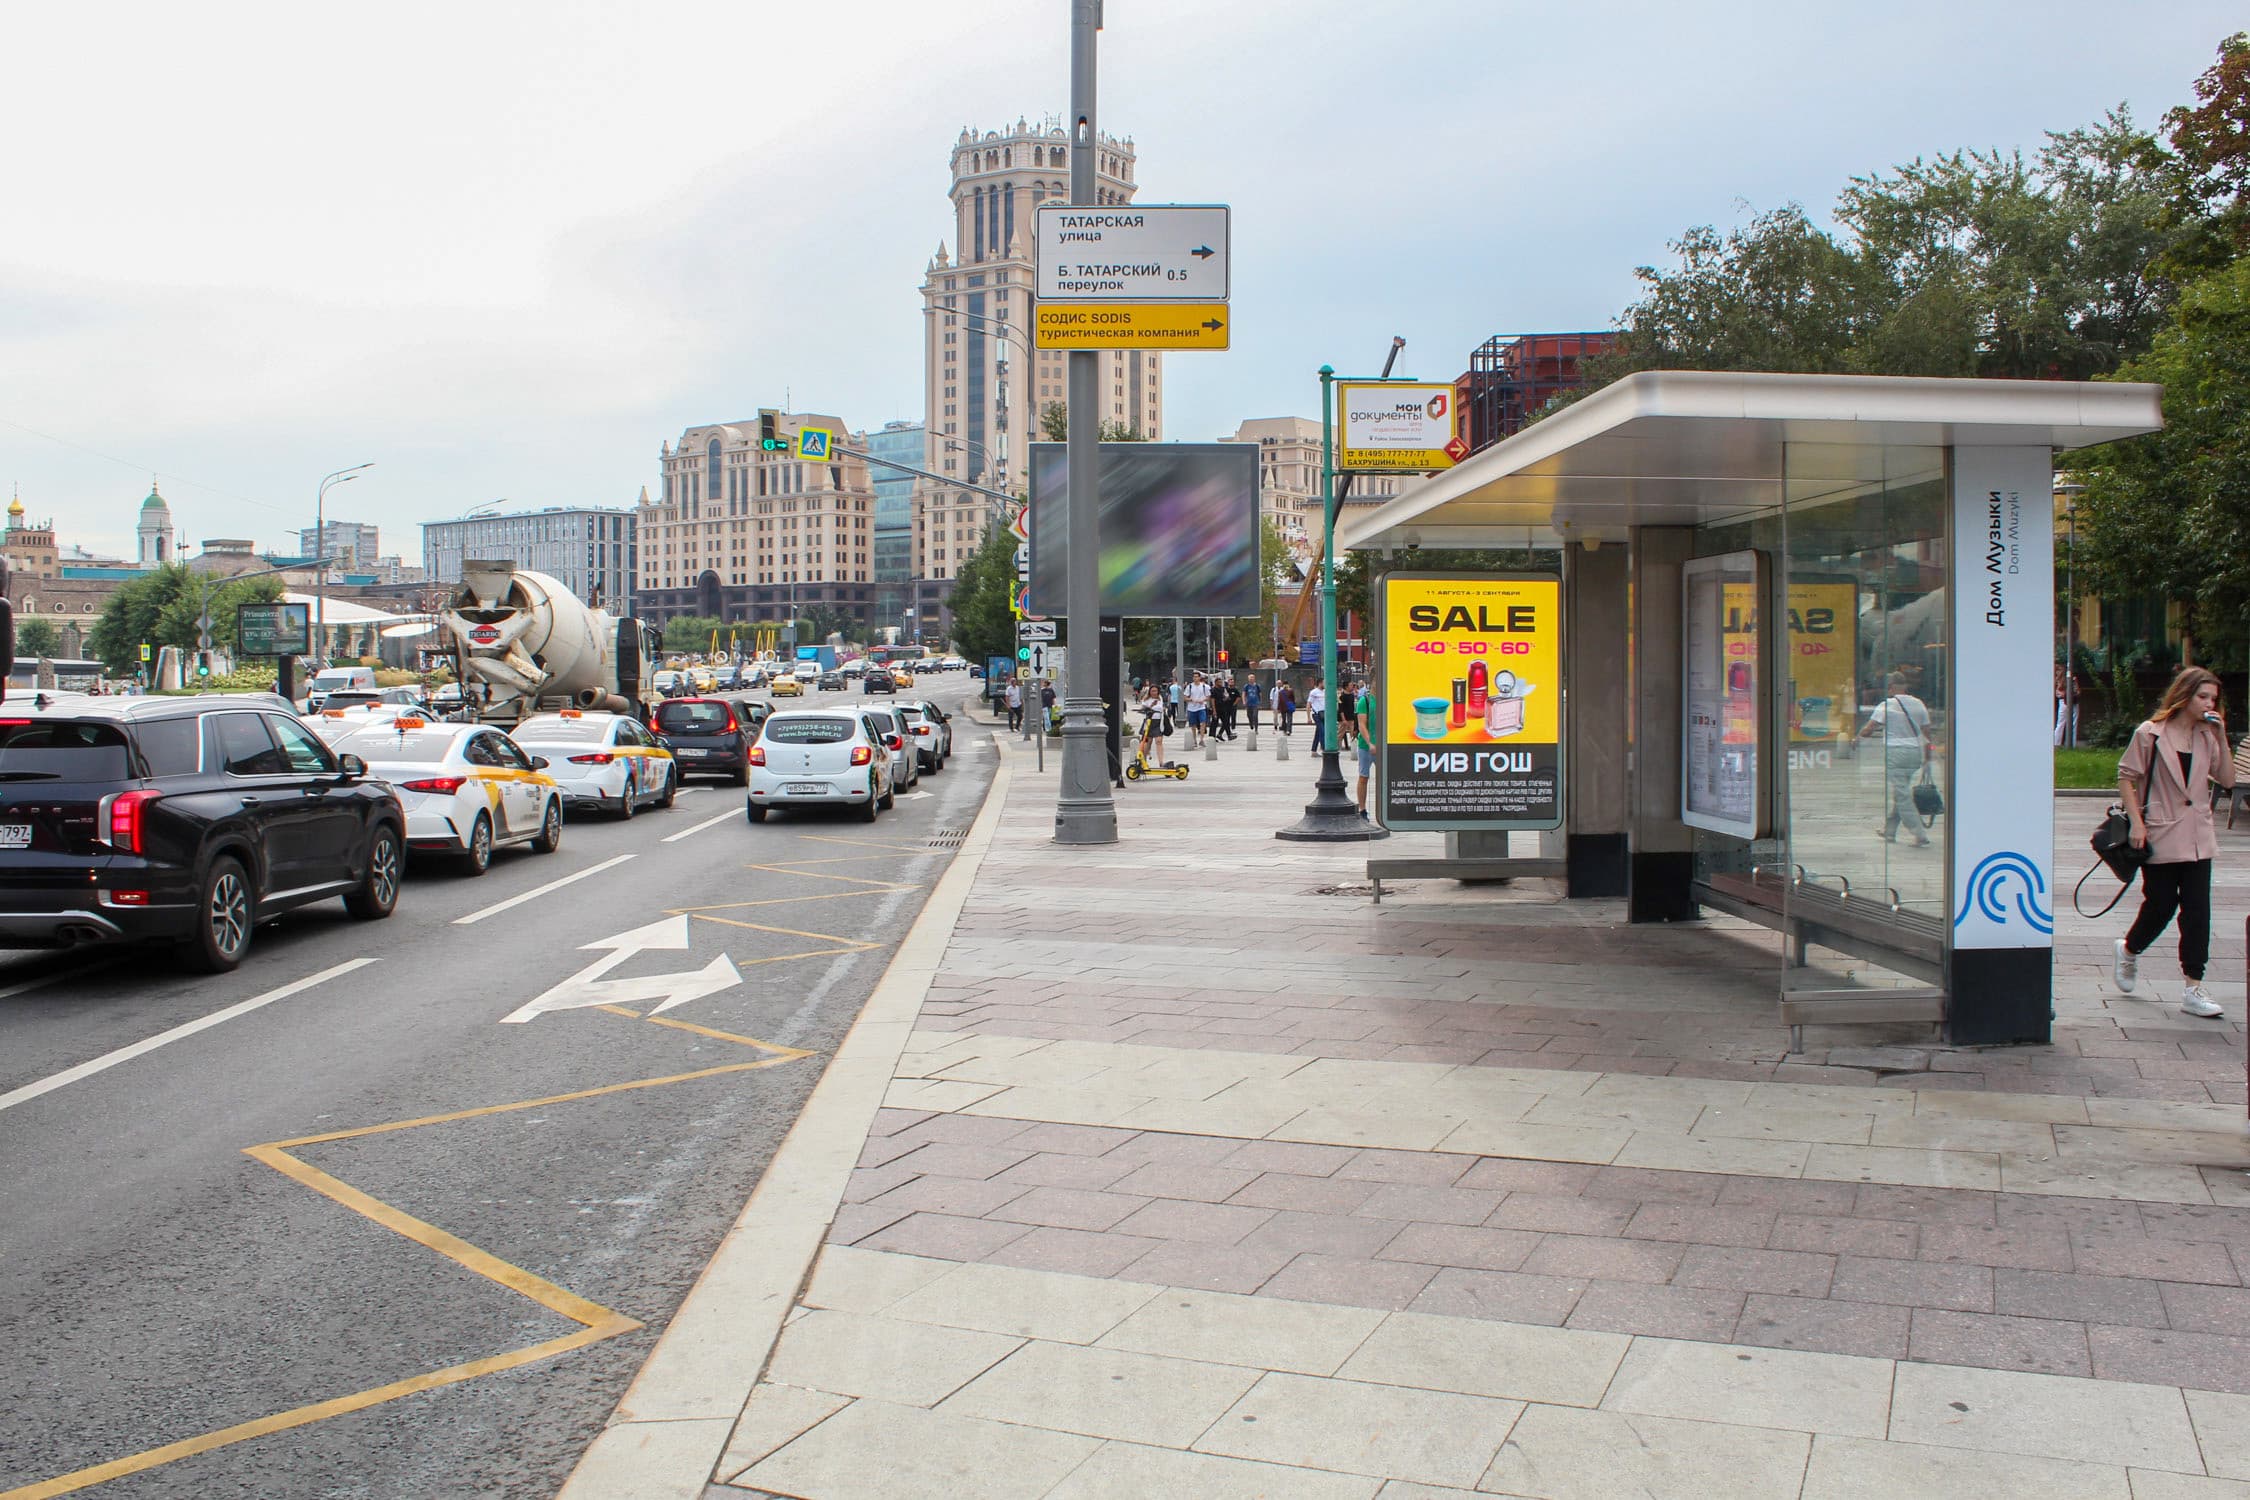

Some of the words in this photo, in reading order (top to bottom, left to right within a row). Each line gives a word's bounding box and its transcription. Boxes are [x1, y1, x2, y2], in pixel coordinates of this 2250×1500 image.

[1059, 216, 1144, 228] ТАТАРСКАЯ
[1058, 231, 1102, 244] улица
[1058, 266, 1072, 276] Б.
[1076, 262, 1161, 276] ТАТАРСКИЙ
[1167, 269, 1188, 281] 0.5
[1058, 280, 1124, 292] переулок
[1040, 313, 1086, 325] СОДИС
[1090, 313, 1132, 324] SODIS
[1040, 328, 1134, 340] туристическая
[1138, 329, 1200, 338] компания
[1350, 411, 1422, 423] документы
[2008, 492, 2021, 540] Muzyki
[1986, 491, 2005, 574] Музыки
[2008, 544, 2019, 574] Dom
[1986, 580, 2005, 626] Дом
[1409, 605, 1536, 632] SALE
[1413, 752, 1469, 773] РИВ
[1475, 752, 1532, 773] ГОШ
[4, 826, 28, 838] 797
